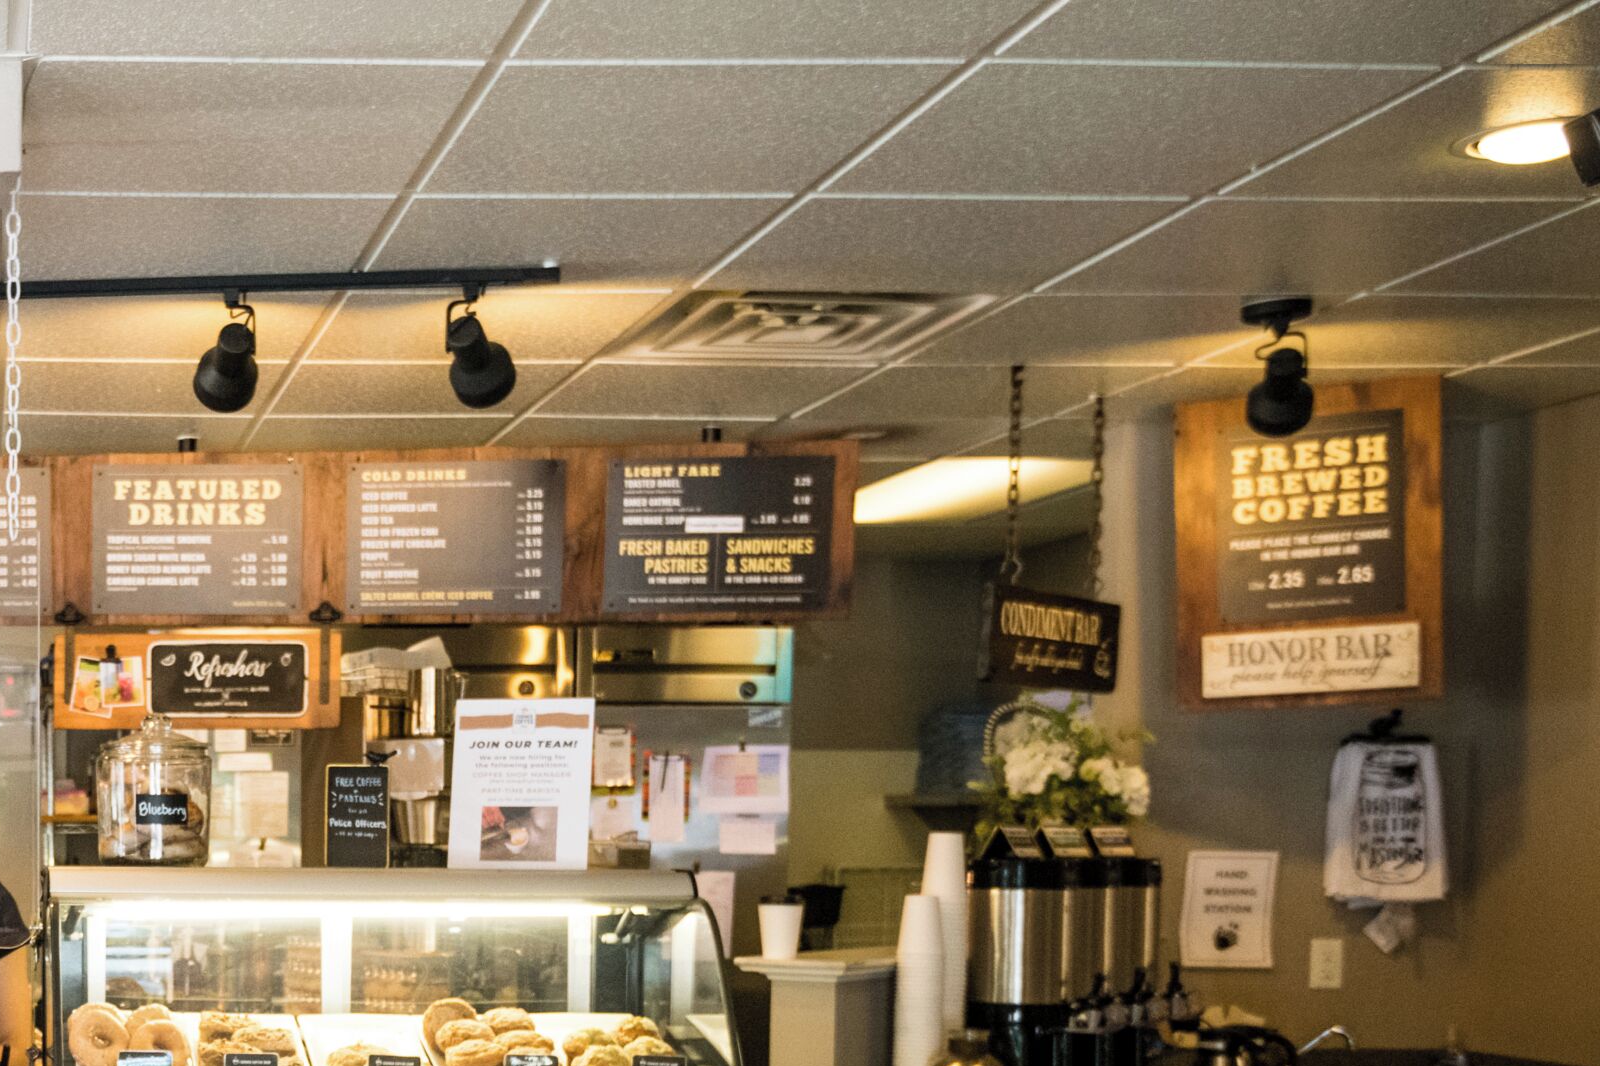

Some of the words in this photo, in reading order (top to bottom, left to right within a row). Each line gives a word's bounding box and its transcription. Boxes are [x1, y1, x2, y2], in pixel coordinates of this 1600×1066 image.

[1231, 434, 1388, 475] FRESH
[361, 470, 402, 482] COLD
[406, 469, 466, 481] DRINKS
[624, 466, 673, 478] LIGHT
[678, 464, 720, 477] FARE
[624, 479, 656, 489] TOASTED
[657, 479, 680, 489] BAGEL
[1231, 466, 1389, 499] BREWED
[114, 479, 282, 500] FEATURED
[380, 491, 408, 501] COFFEE
[417, 503, 438, 512] LATTE
[623, 498, 648, 507] BAKED
[648, 497, 681, 507] OATMEAL
[1232, 489, 1389, 525] COFFEE
[128, 503, 266, 525] DRINKS
[622, 516, 663, 526] HOMEMADE
[664, 516, 685, 525] SOUP
[619, 540, 663, 557] FRESH
[665, 539, 709, 556] BAKED
[726, 538, 815, 555] SANDWICHES
[644, 557, 708, 574] PASTRIES
[725, 558, 737, 574] &
[739, 557, 792, 573] SNACKS
[1268, 570, 1305, 590] 2.35
[1337, 564, 1374, 585] 2.65
[465, 591, 494, 600] COFFEE
[1001, 601, 1075, 642] CONDIMENT
[1075, 612, 1099, 646] BAR
[1227, 636, 1325, 668] HONOR
[1336, 633, 1392, 661] BAR
[184, 649, 272, 688] Refreshers
[1231, 666, 1277, 685] please
[1282, 661, 1314, 684] help
[1319, 655, 1381, 688] yourself
[469, 740, 500, 749] JOIN
[504, 740, 532, 749] OUR
[538, 740, 579, 749] TEAM!
[528, 753, 552, 763] hiring
[335, 776, 354, 787] FREE
[356, 776, 382, 787] COFFEE
[139, 801, 187, 822] Blueberry
[329, 818, 352, 828] Police
[355, 819, 387, 829] Officers
[1216, 871, 1248, 880] HAND
[1204, 887, 1257, 897] WASHING
[1204, 904, 1252, 913] STATION
